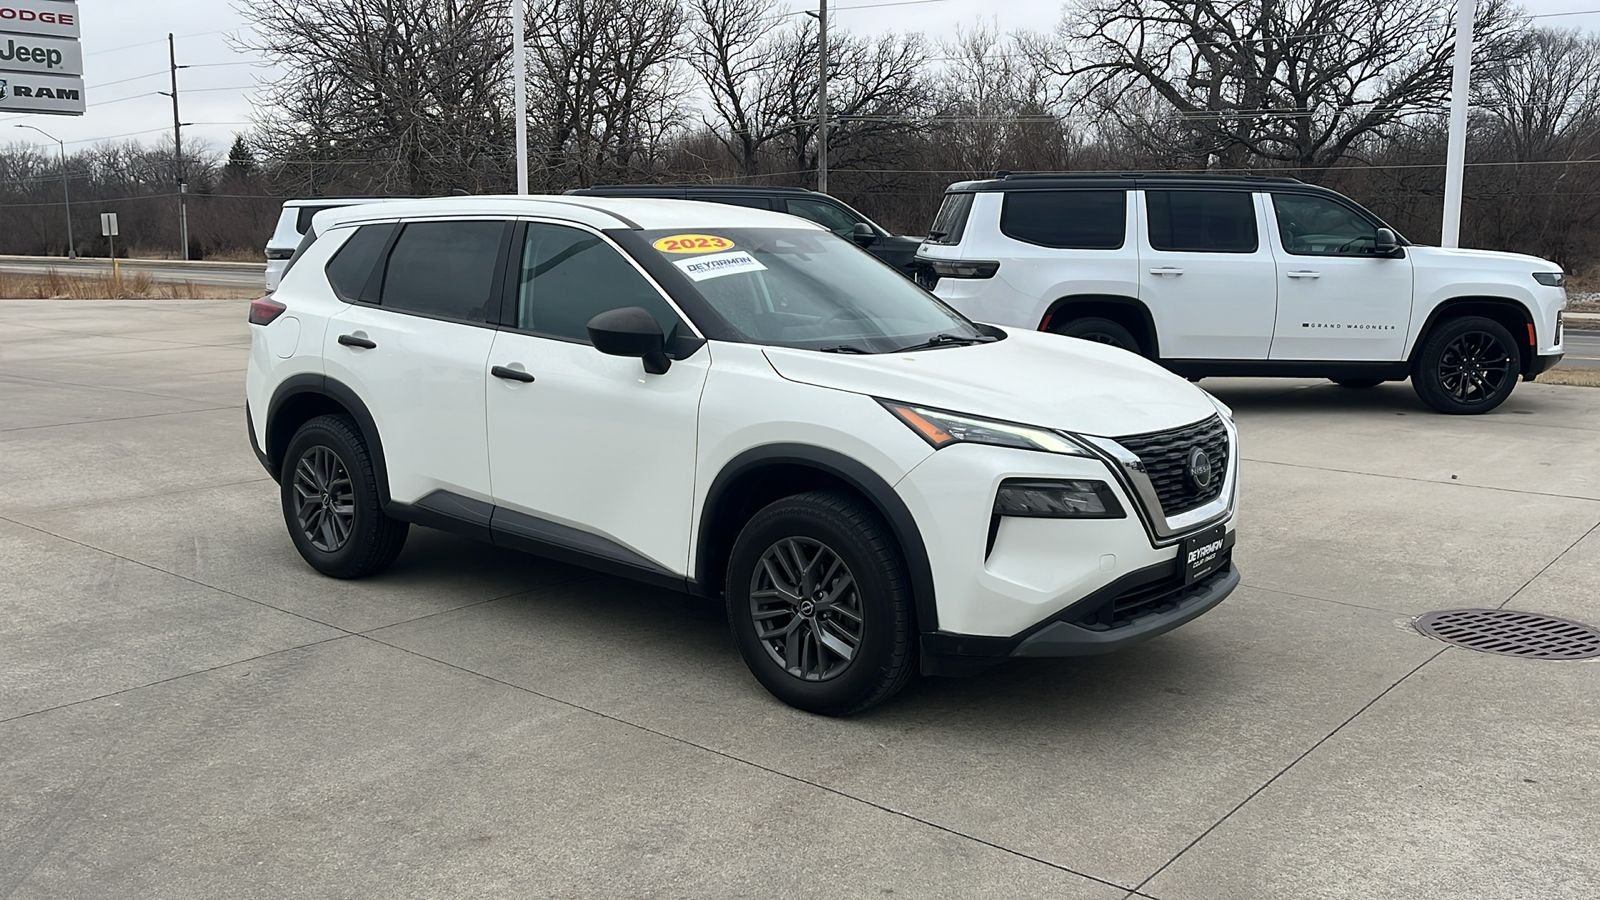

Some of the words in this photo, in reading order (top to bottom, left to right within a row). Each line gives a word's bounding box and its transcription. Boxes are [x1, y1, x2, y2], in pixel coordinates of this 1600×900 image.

[0, 39, 62, 69] Jeep
[13, 85, 80, 101] RAM
[664, 238, 727, 251] 2023
[686, 256, 752, 272] DEYARMAN
[1187, 538, 1224, 564] DEYARMAN
